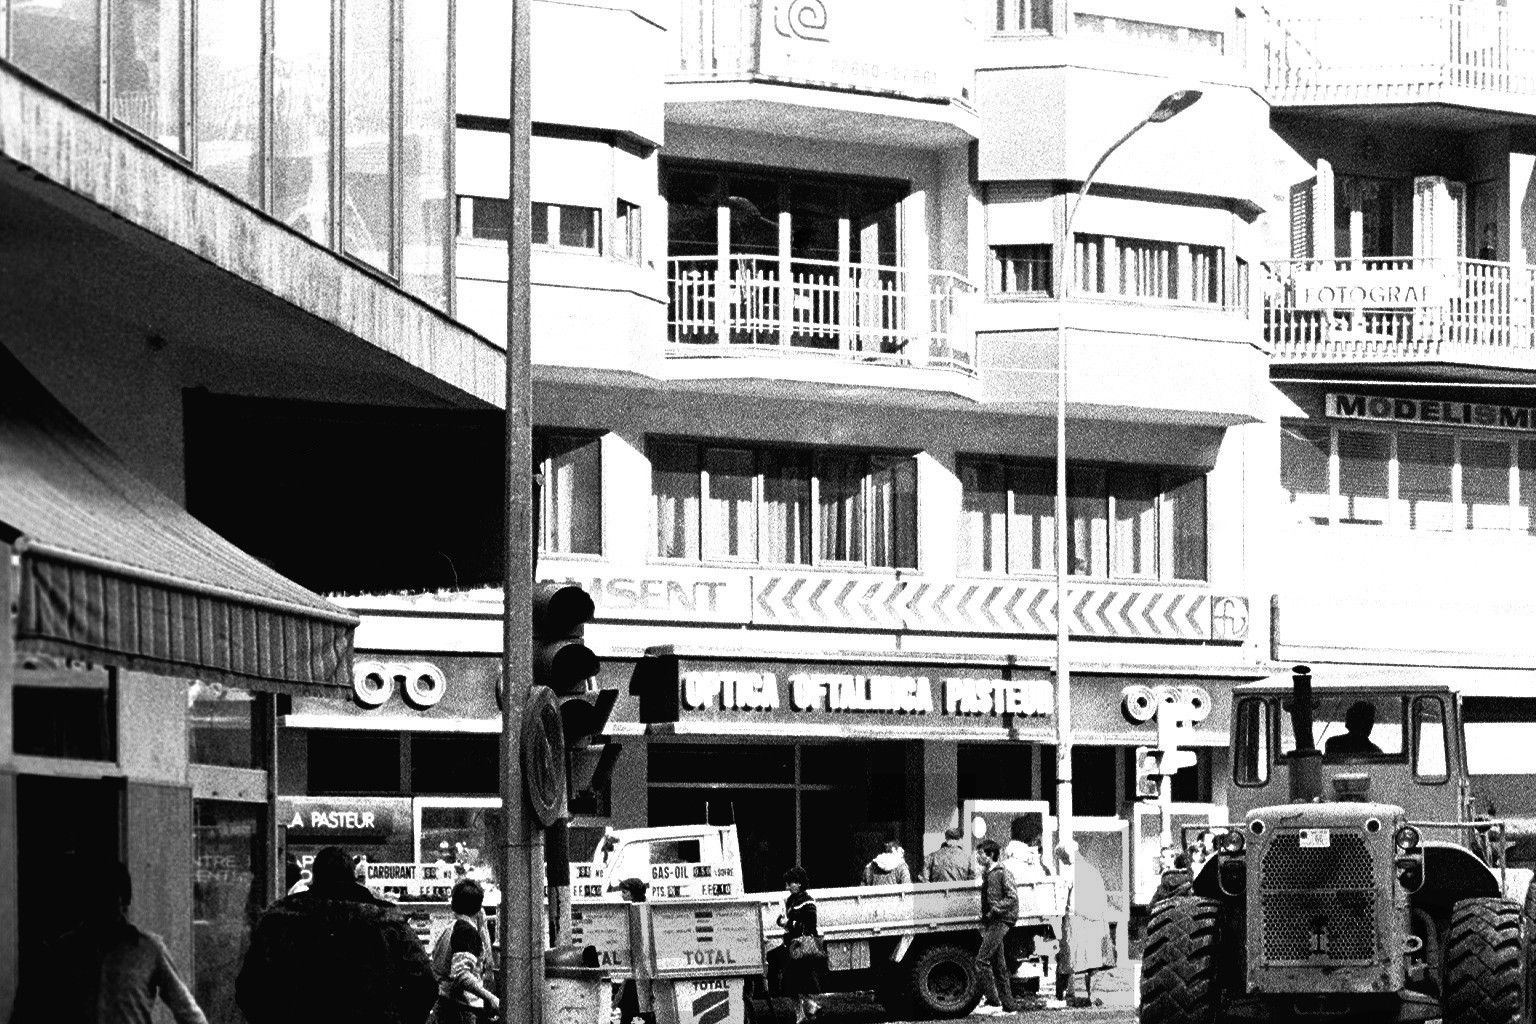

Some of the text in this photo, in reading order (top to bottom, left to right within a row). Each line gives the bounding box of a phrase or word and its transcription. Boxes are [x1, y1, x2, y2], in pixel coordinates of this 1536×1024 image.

[311, 811, 375, 829] PASTEUR
[367, 865, 416, 880] CARBURANT
[652, 865, 689, 880] GAS-OIL
[683, 950, 736, 965] TOTAL
[692, 980, 730, 991] TOTAL
